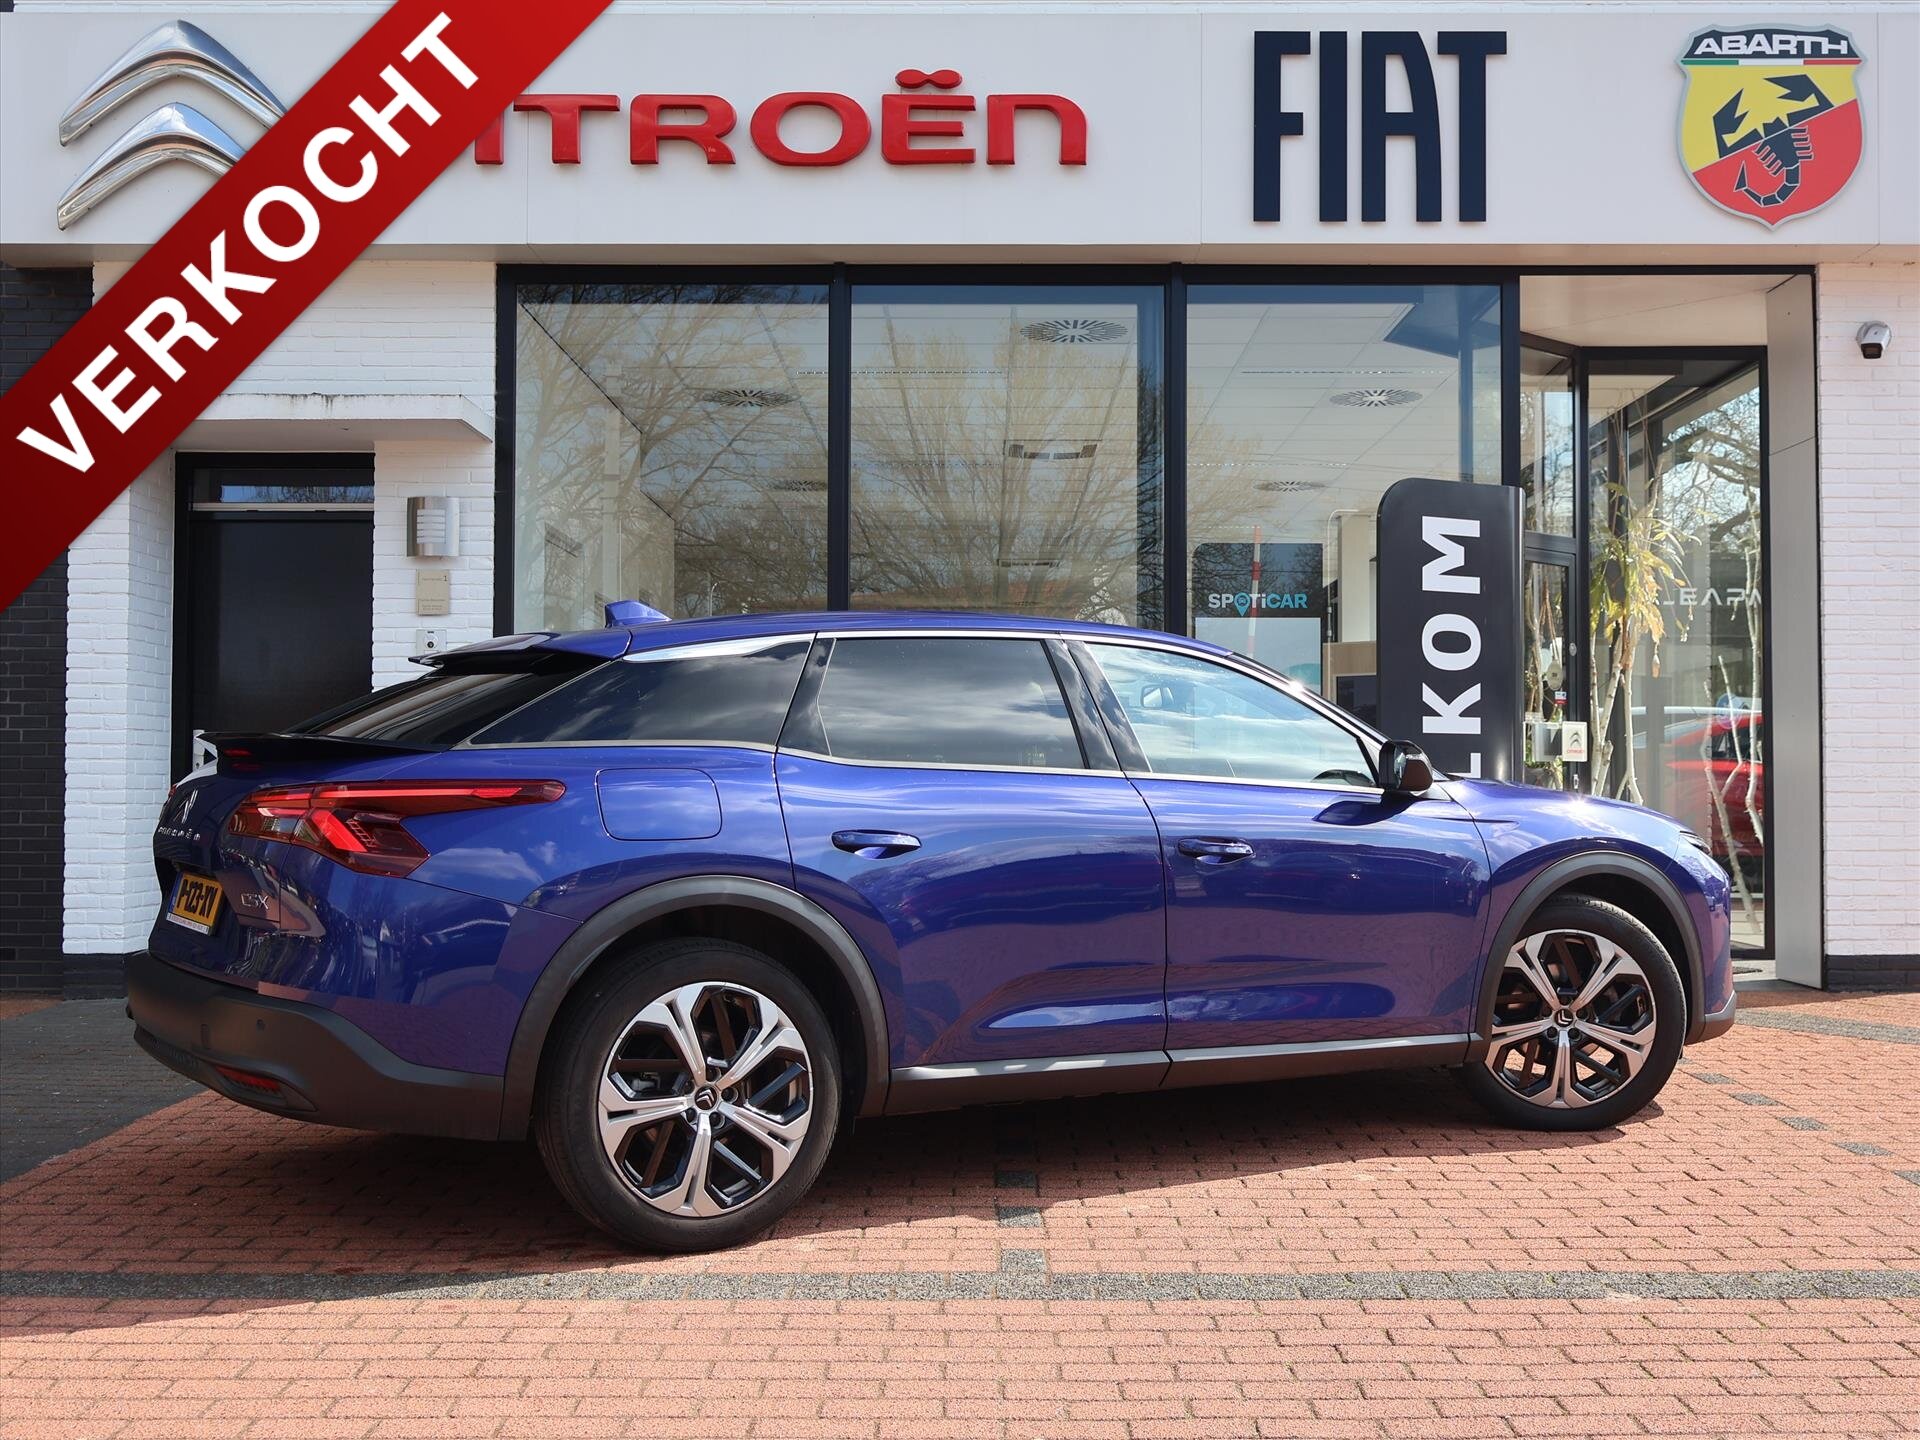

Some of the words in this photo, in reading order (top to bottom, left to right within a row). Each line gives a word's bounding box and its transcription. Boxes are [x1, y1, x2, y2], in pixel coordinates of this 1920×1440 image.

[1694, 34, 1848, 55] ABARTH
[475, 69, 1089, 166] ITROËN
[1253, 31, 1507, 222] FIAT
